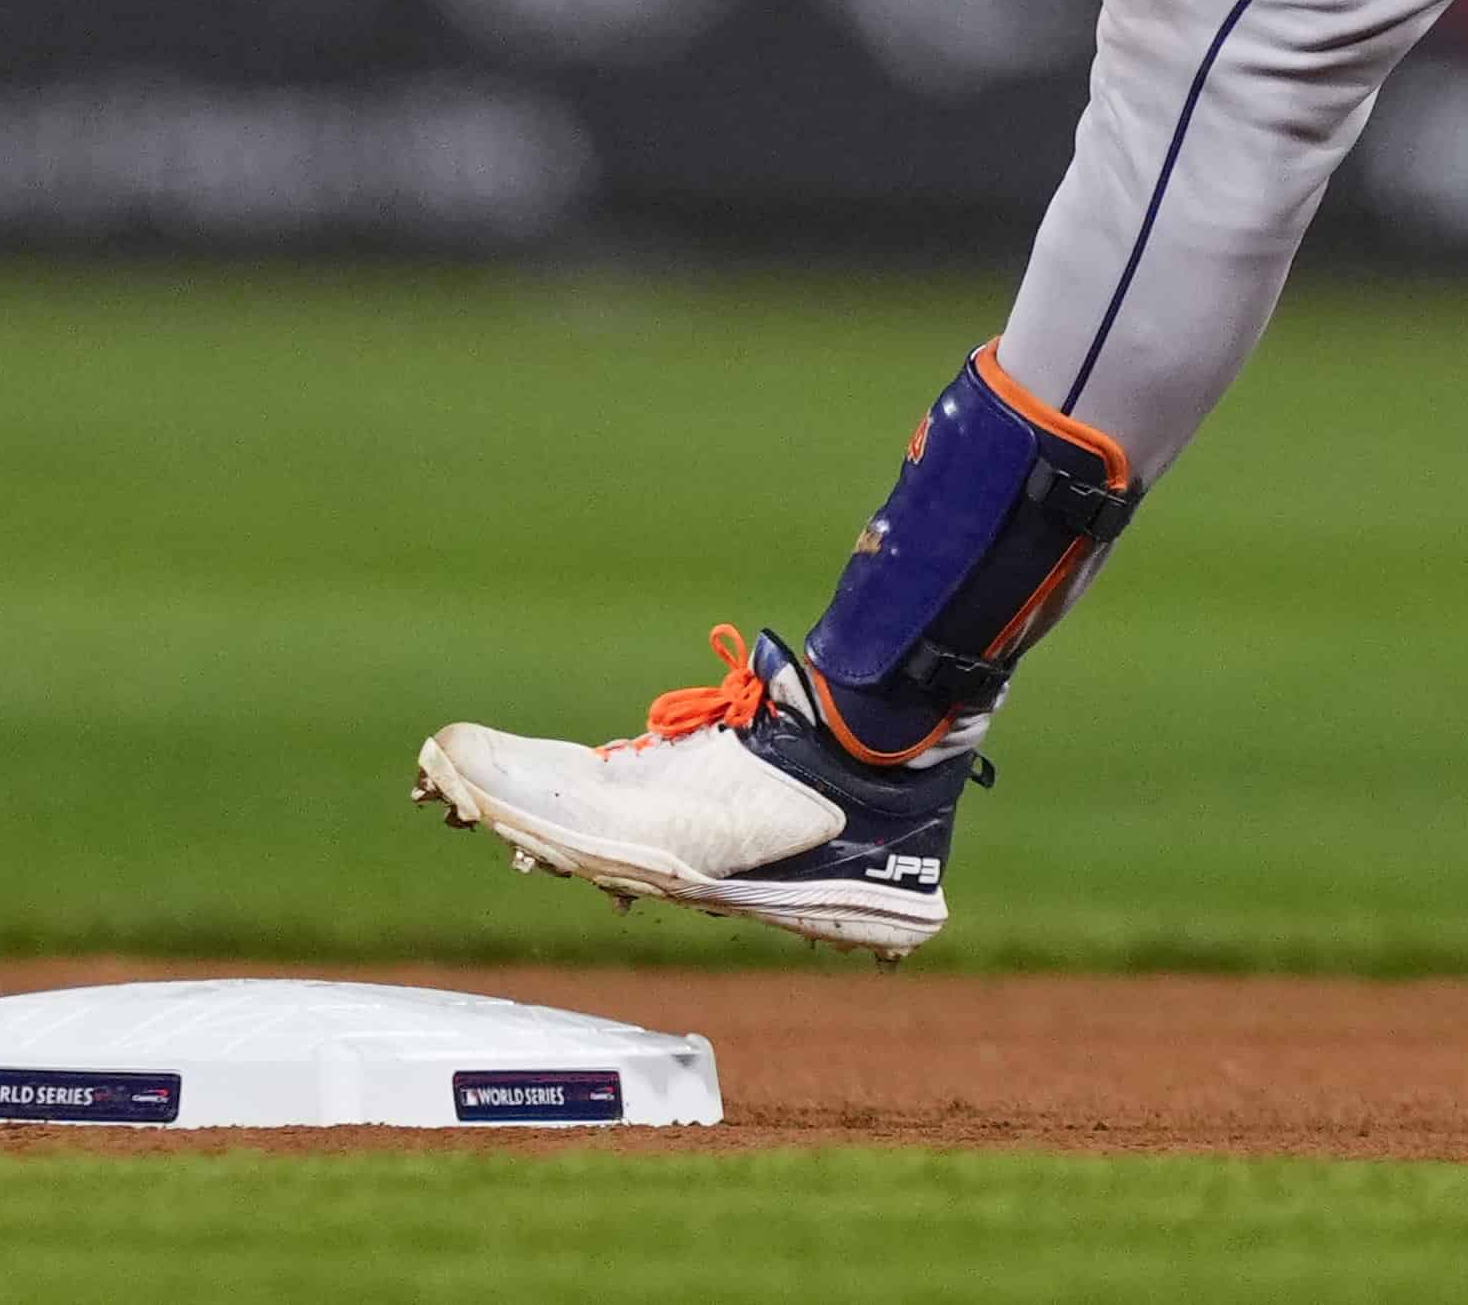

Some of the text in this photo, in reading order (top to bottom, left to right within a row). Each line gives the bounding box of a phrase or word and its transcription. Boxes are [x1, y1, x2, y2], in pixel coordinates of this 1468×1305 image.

[864, 853, 941, 884] JP3
[35, 1087, 94, 1106] SERIES
[477, 1086, 565, 1106] WORLD SERIES
